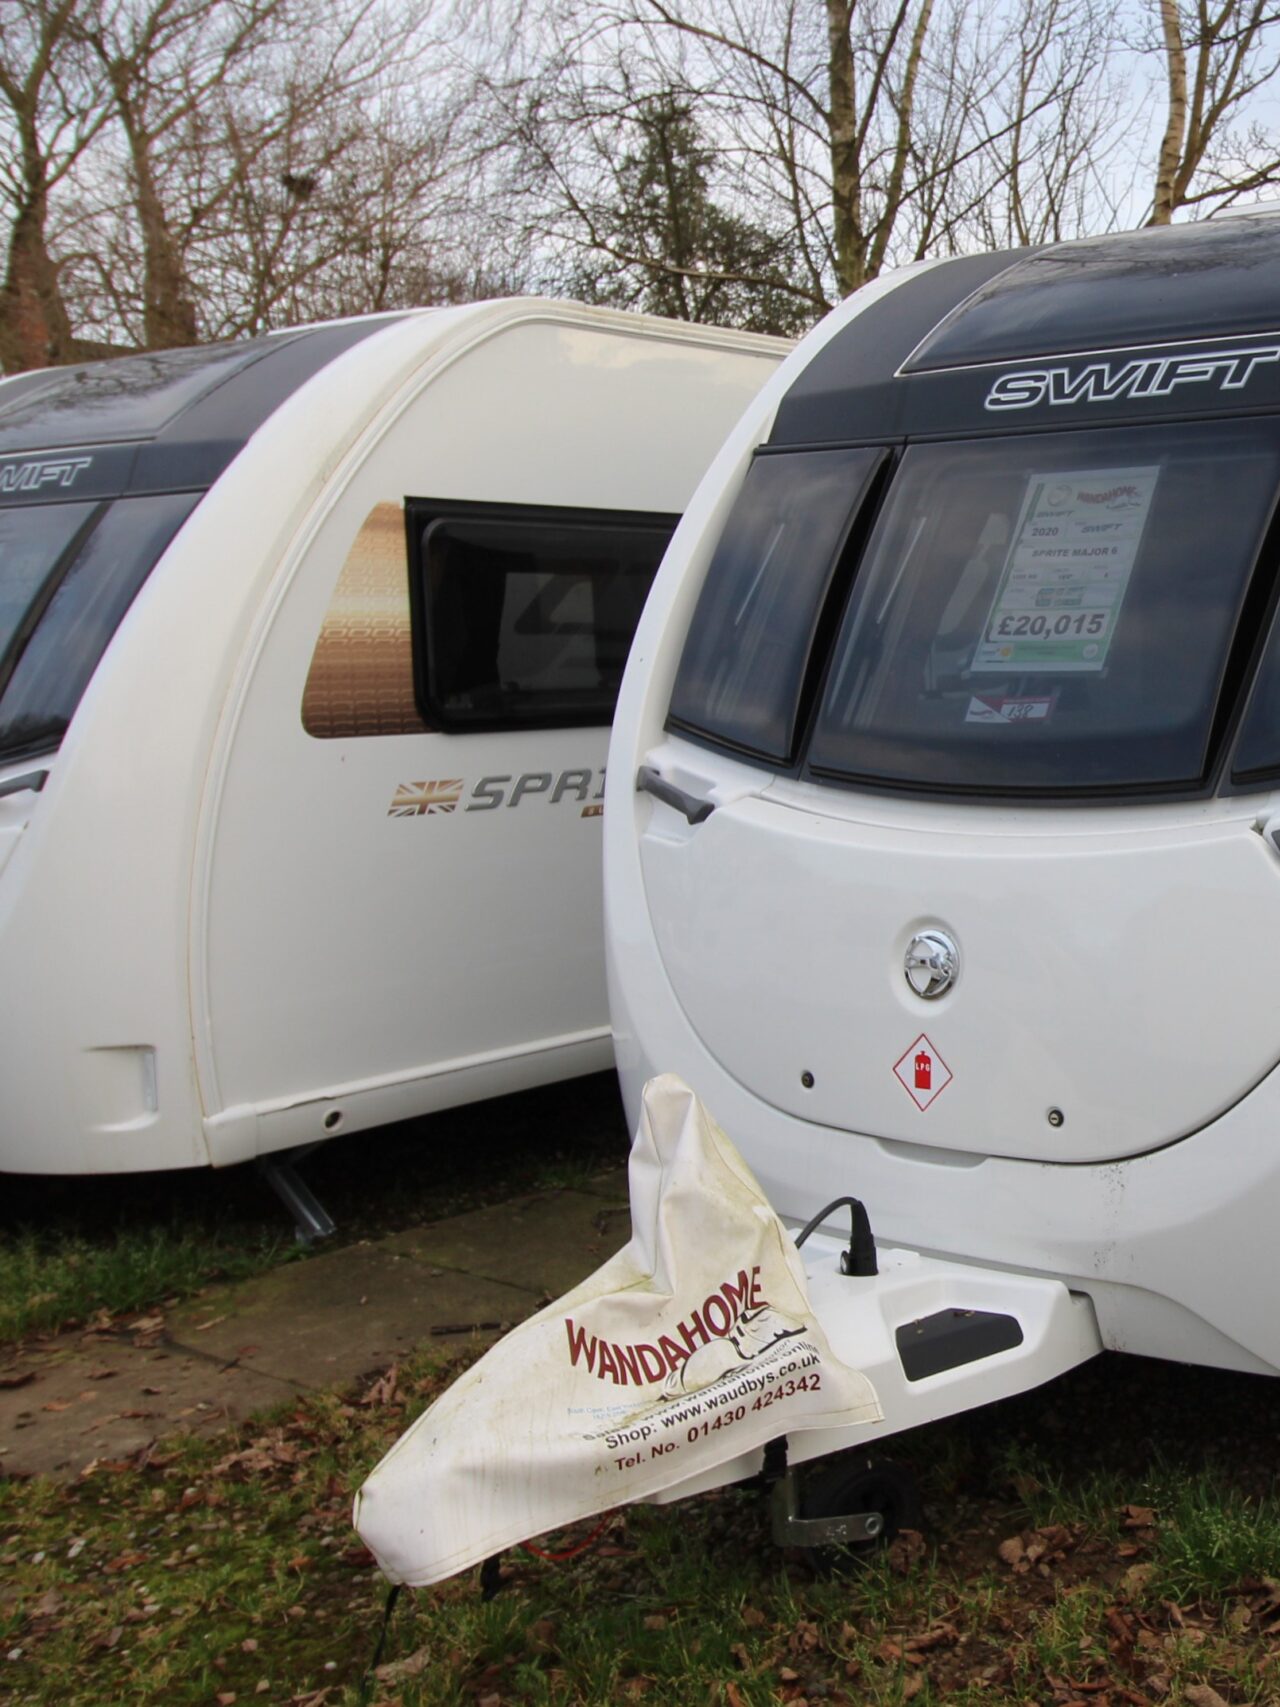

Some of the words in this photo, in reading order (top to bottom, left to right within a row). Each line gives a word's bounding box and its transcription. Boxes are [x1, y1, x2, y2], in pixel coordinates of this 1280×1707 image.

[0, 456, 93, 492] WIFT
[1032, 527, 1060, 537] 2020
[1032, 549, 1069, 558] SPRITE
[1072, 547, 1109, 556] MAJOR
[1111, 546, 1118, 555] 6
[997, 613, 1105, 640] £20,015
[464, 768, 606, 811] SPRI
[915, 1062, 930, 1072] LPG
[565, 1266, 769, 1386] WANDAHOME
[605, 1423, 657, 1450] Shop:
[661, 1352, 821, 1428] www.waudbys.co.uk
[614, 1455, 646, 1472] Tel.
[651, 1442, 680, 1458] No.
[687, 1405, 746, 1443] 01430
[751, 1373, 822, 1412] 424342
